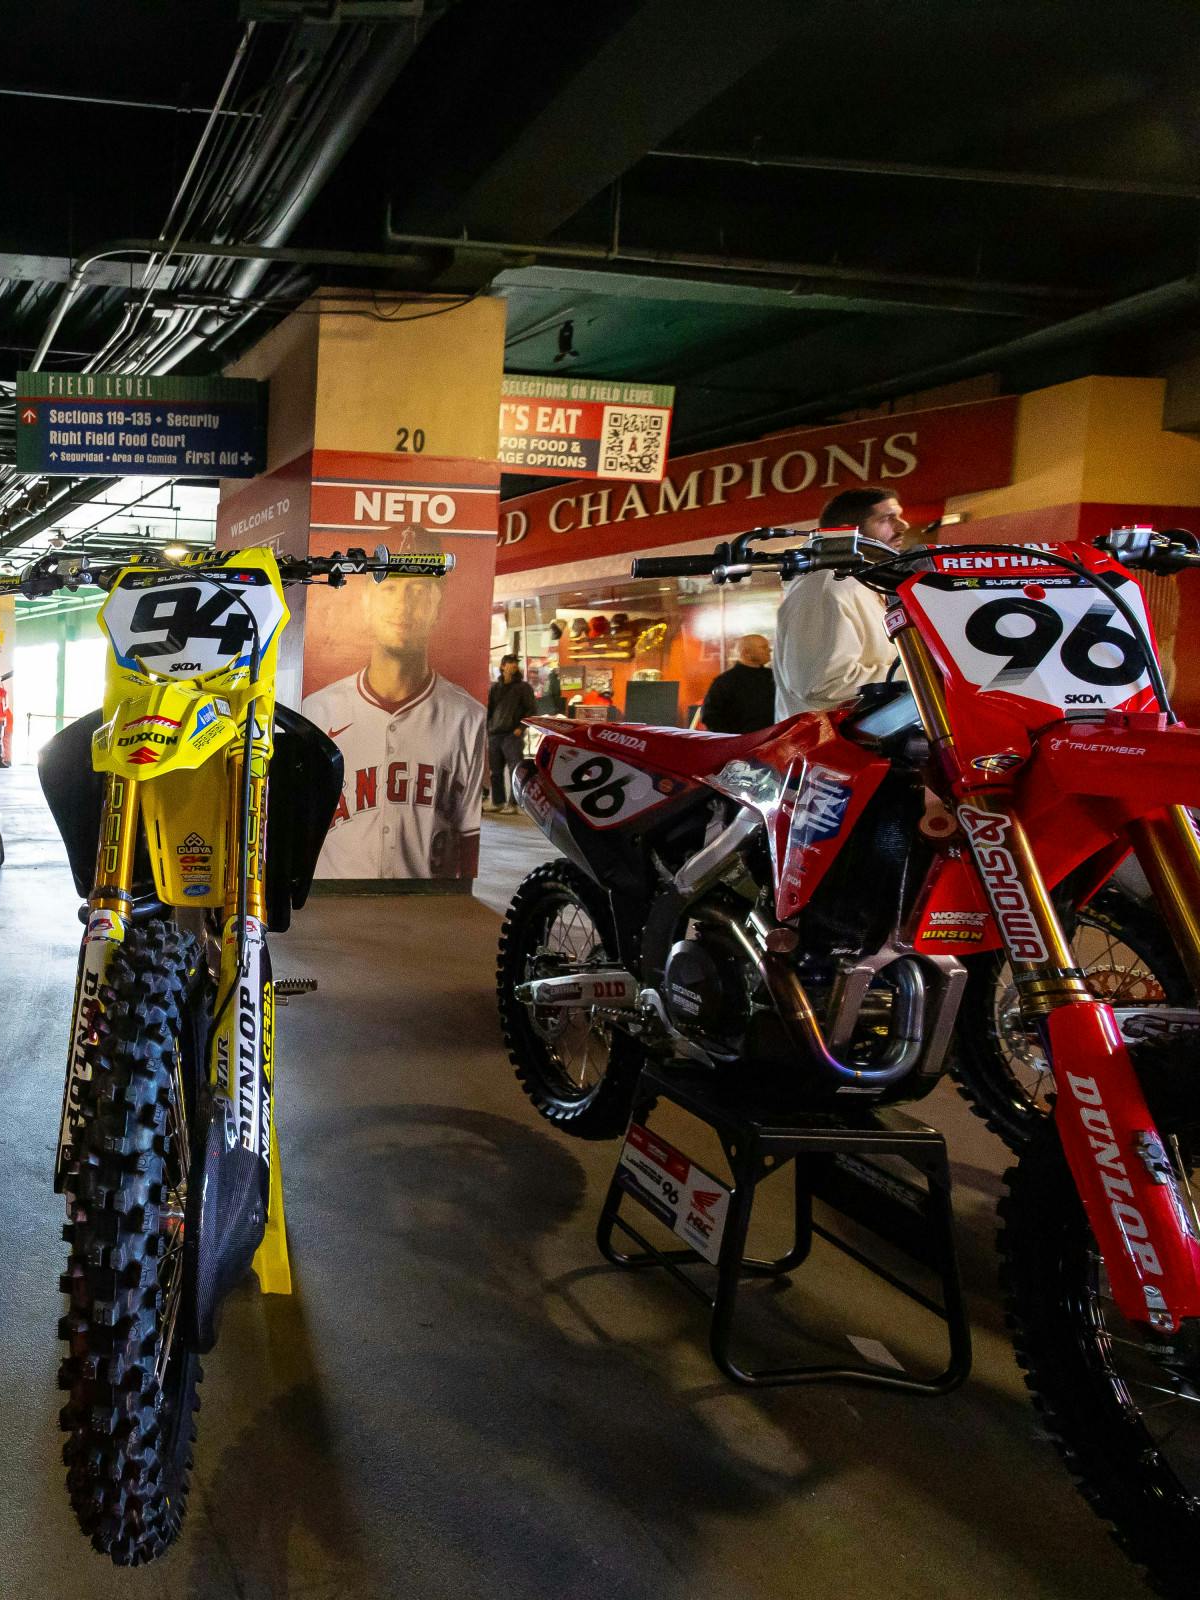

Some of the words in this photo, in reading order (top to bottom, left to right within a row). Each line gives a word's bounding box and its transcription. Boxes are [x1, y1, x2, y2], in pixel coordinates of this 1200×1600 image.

[48, 376, 95, 397] FIELD
[106, 377, 153, 397] LEVEL
[501, 380, 568, 397] SELECTIONS
[589, 385, 621, 402] FIELD
[623, 388, 656, 404] LEVEL
[49, 409, 104, 425] Sections
[106, 411, 151, 426] 119-135
[166, 413, 220, 429] Security
[536, 407, 582, 434] EAT
[49, 430, 82, 446] Right
[85, 431, 115, 446] Field
[118, 432, 148, 447] Food
[151, 433, 186, 448] Court
[395, 428, 425, 453] 20
[499, 437, 527, 449] FOR
[529, 438, 569, 453] FOOD
[570, 441, 581, 453] &
[60, 452, 104, 463] Seguridad
[134, 453, 144, 463] de
[146, 453, 177, 464] Comida
[185, 450, 215, 465] First
[219, 451, 238, 466] Aid
[526, 453, 588, 468] OPTIONS
[548, 431, 919, 533] CHAMPIONS
[231, 505, 275, 538] WELCOME
[277, 498, 290, 516] TO
[354, 491, 456, 525] NETO
[331, 563, 365, 573] ASV
[943, 555, 1057, 569] RENTHA
[985, 578, 1071, 586] SUPERCROSS
[127, 586, 256, 658] 94
[965, 597, 1150, 692] 96
[1064, 694, 1103, 705] SKDA
[117, 731, 179, 747] DIXXON
[597, 728, 648, 753] HONDA
[1068, 741, 1146, 756] TRUETIMBER
[560, 756, 637, 819] 96
[178, 846, 212, 854] DUBYA
[976, 848, 1046, 961] SHOWA
[930, 911, 989, 920] WORKS
[922, 930, 983, 940] HINSON
[593, 982, 626, 998] DID
[239, 991, 257, 1153] DUNLOP
[1066, 1071, 1164, 1276] DUNLOP
[662, 1182, 679, 1204] 96
